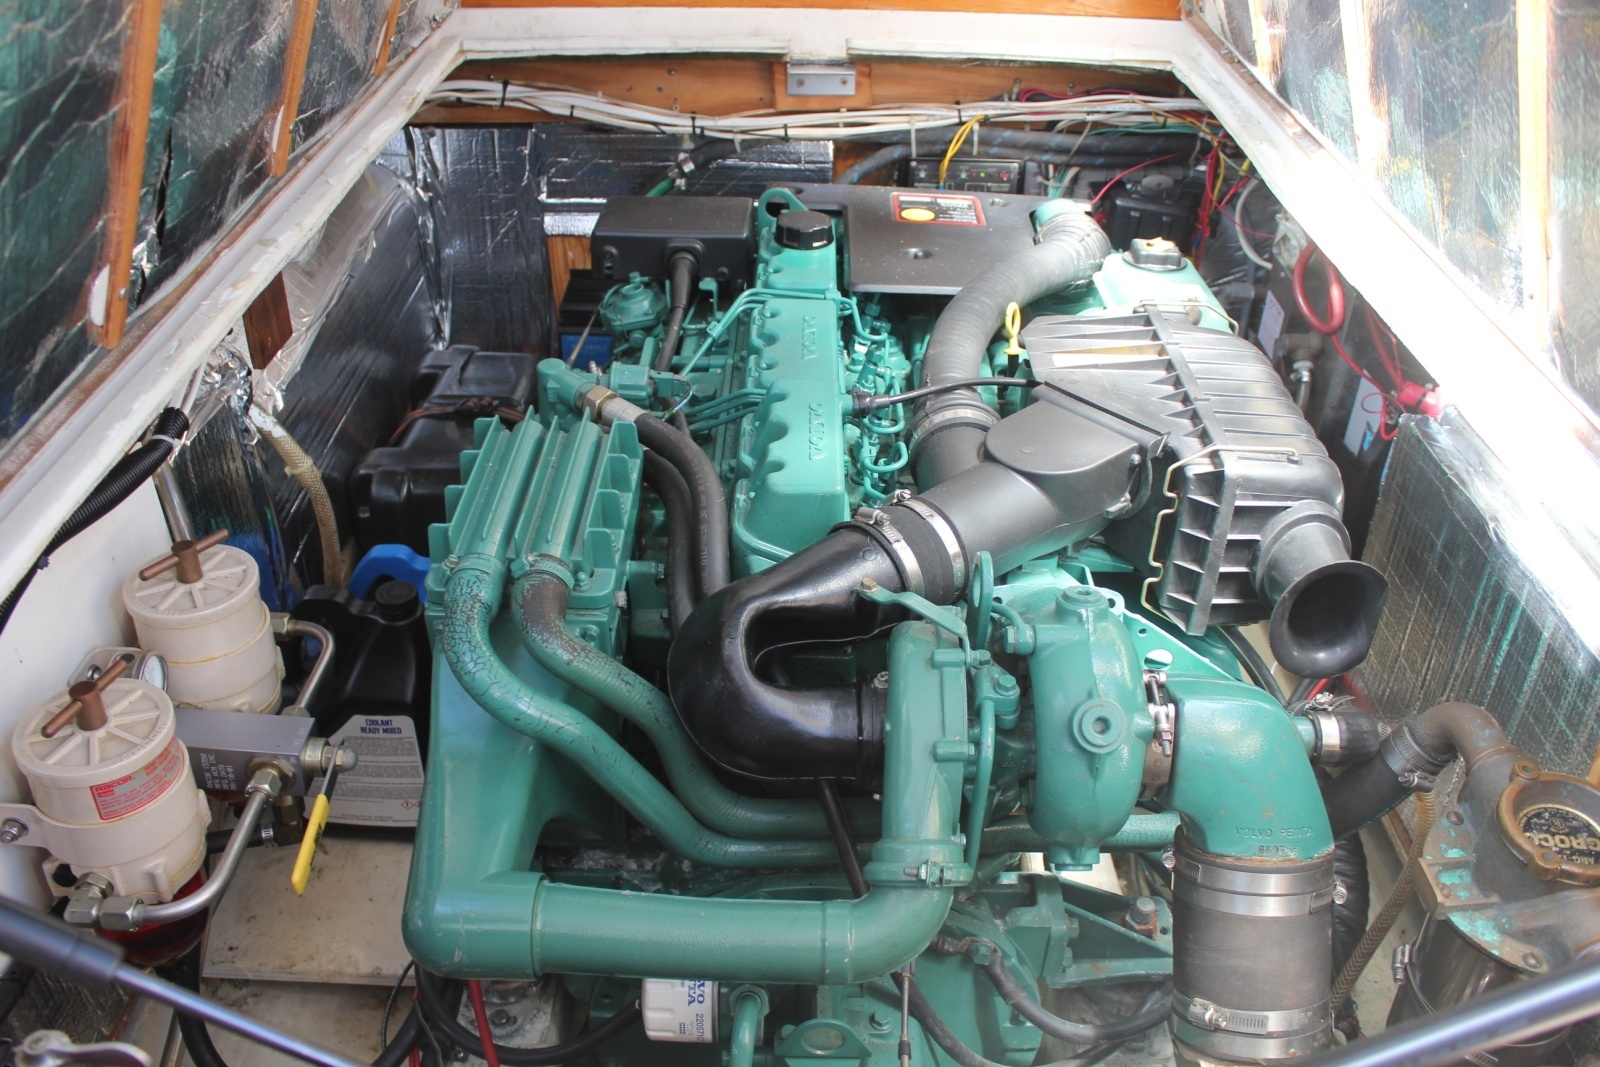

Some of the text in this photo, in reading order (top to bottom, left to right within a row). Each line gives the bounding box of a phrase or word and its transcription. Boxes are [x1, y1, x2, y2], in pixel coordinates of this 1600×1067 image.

[802, 315, 818, 360] VOLVO
[808, 400, 827, 460] VOLVO
[365, 719, 393, 727] COOLANT
[360, 726, 380, 734] READY
[1235, 826, 1314, 839] VOLVO PENTA
[1559, 854, 1595, 865] ARG-1
